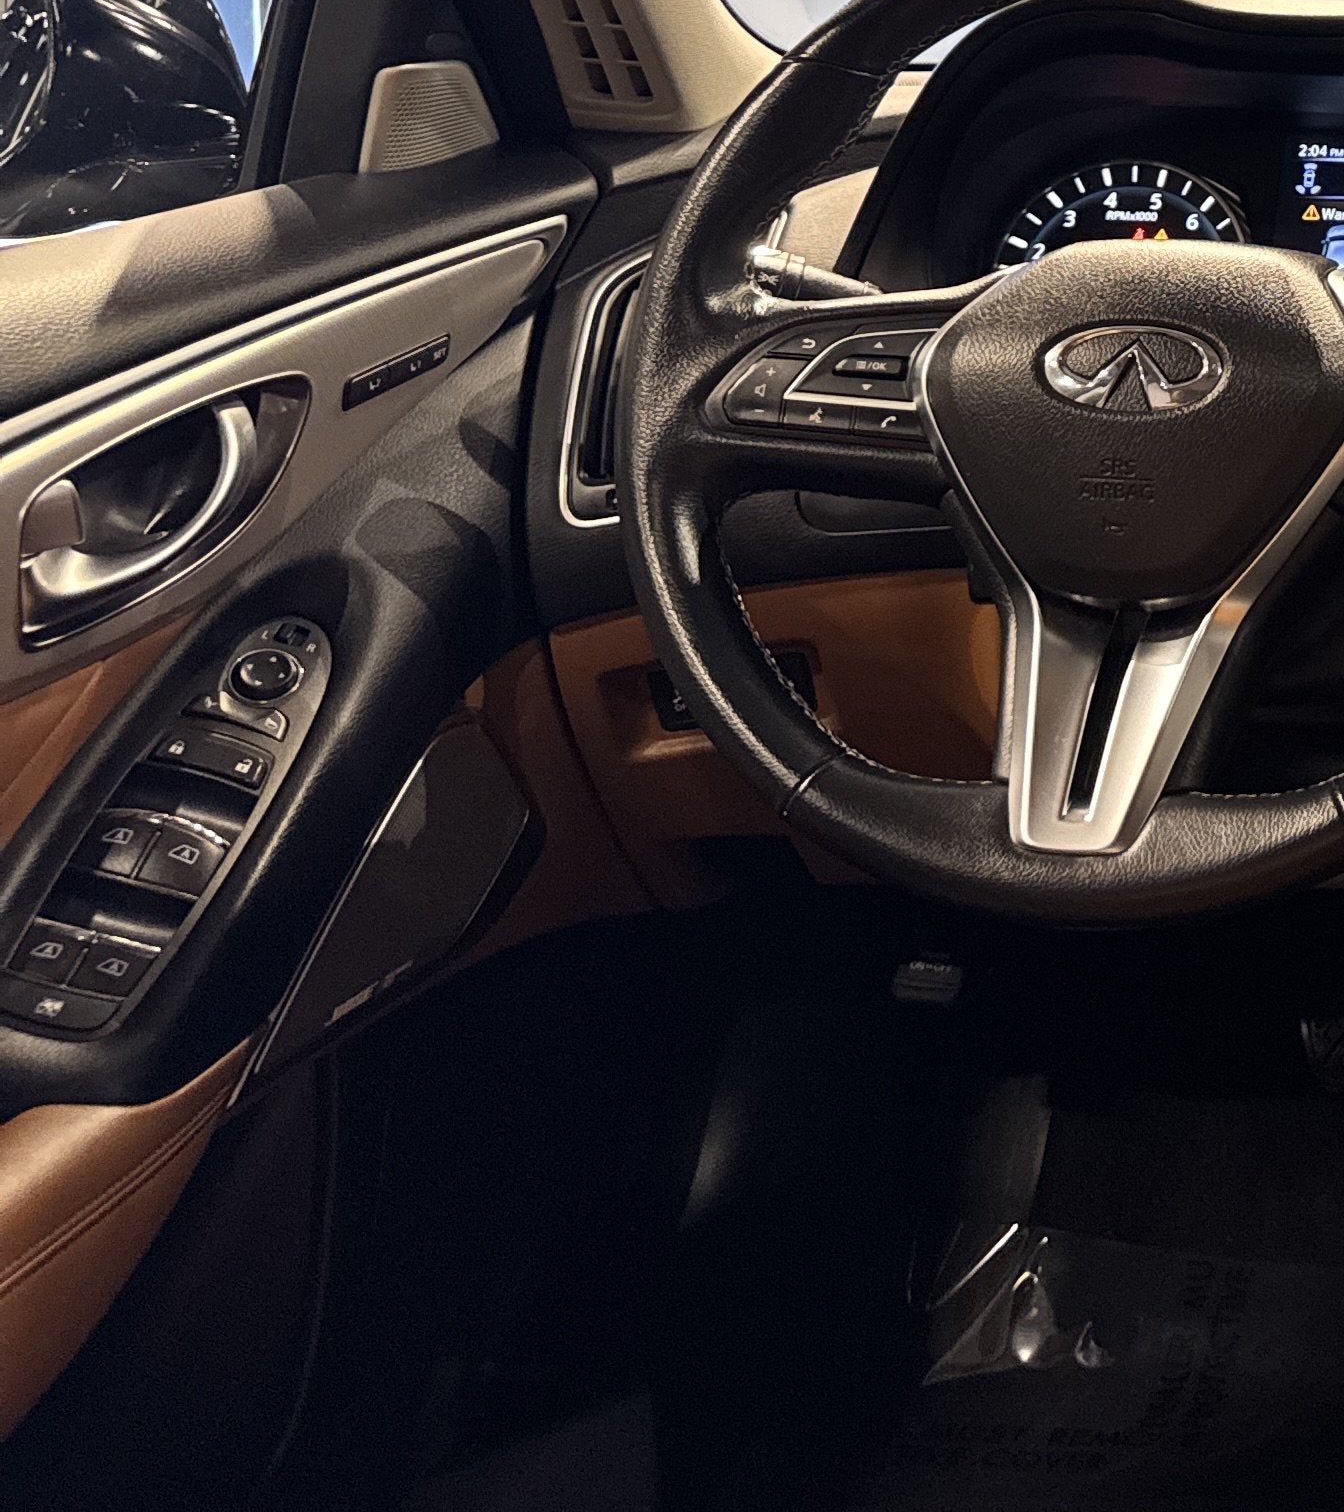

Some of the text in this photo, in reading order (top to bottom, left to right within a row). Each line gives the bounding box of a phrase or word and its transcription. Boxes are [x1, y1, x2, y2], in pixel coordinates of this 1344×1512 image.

[1298, 144, 1328, 157] 2:04
[1329, 148, 1344, 158] PM
[1103, 191, 1163, 210] 4 5
[1063, 210, 1076, 228] 3
[1185, 213, 1199, 231] 6
[261, 630, 269, 640] L
[306, 643, 317, 653] R
